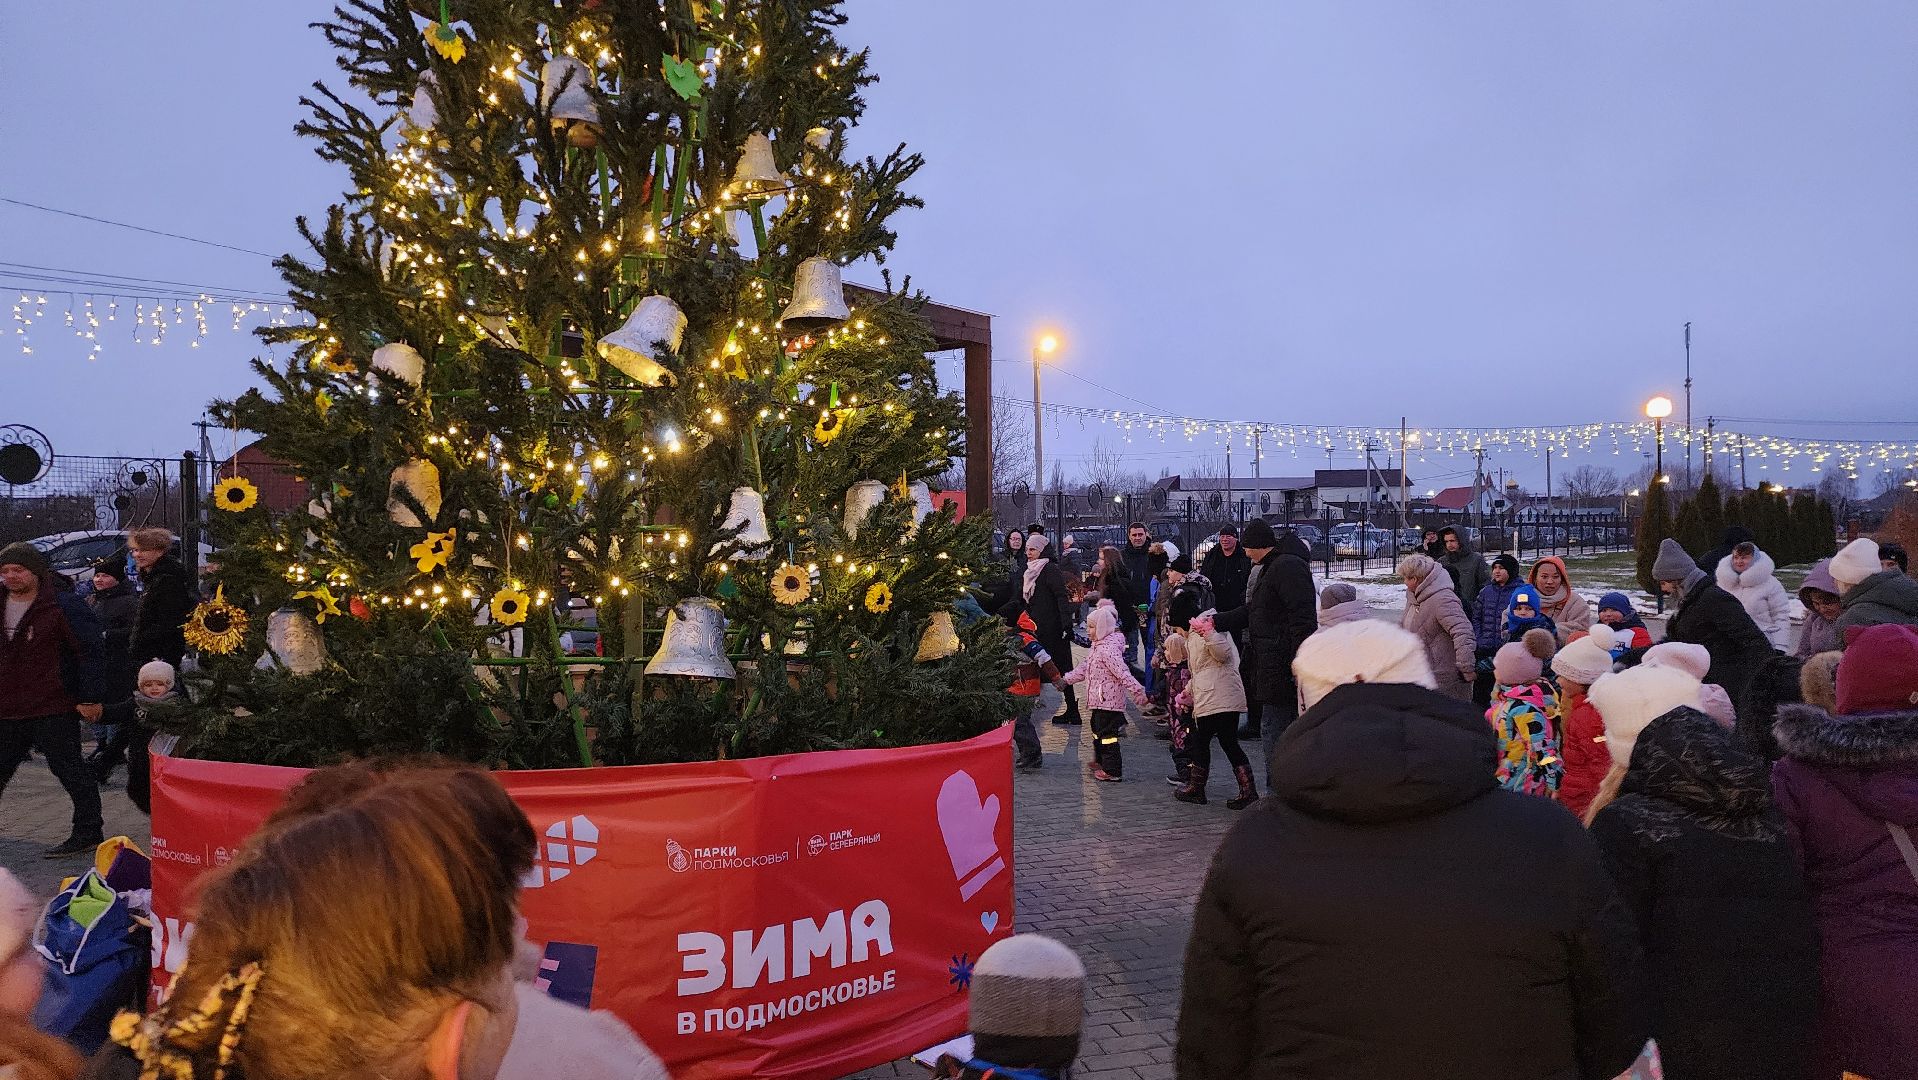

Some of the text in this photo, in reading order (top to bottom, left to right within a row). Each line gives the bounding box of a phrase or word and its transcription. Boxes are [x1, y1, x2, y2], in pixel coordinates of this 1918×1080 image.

[151, 836, 167, 848] РКИ
[829, 828, 853, 841] ПАРК
[829, 832, 881, 851] СЕРЕБРЯНЫЙ
[151, 847, 201, 864] ДМОСКОВЬЯ
[694, 846, 737, 858] ПАРКИ
[694, 851, 789, 870] ПОДМОСКОВЬЯ
[677, 899, 894, 997] ЗИМА
[677, 969, 896, 1034] В ПОДМОСКОВЬЕ
